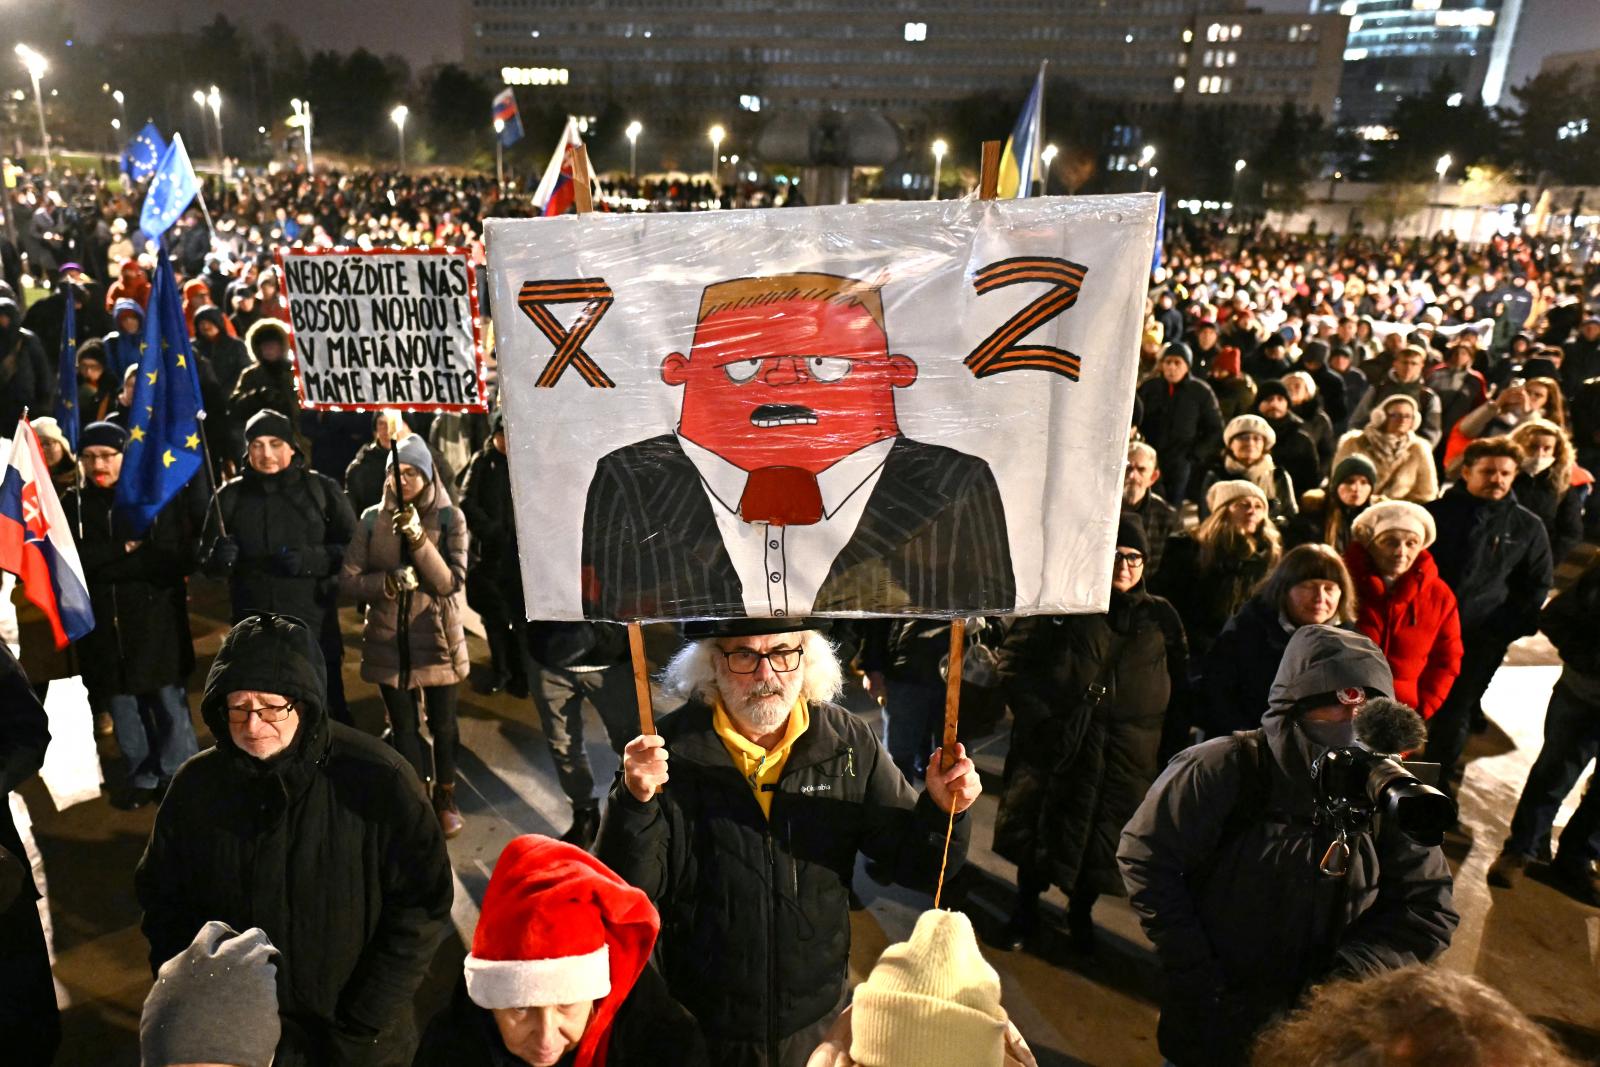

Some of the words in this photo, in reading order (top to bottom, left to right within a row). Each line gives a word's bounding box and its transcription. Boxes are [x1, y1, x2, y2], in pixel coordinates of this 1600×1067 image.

[285, 257, 409, 295] NEDRÁŽDITE
[418, 257, 467, 297] NÁS
[290, 299, 360, 332] BOSOU
[298, 337, 315, 367] V
[304, 369, 365, 403] MÁME
[371, 369, 413, 403] MAŤ
